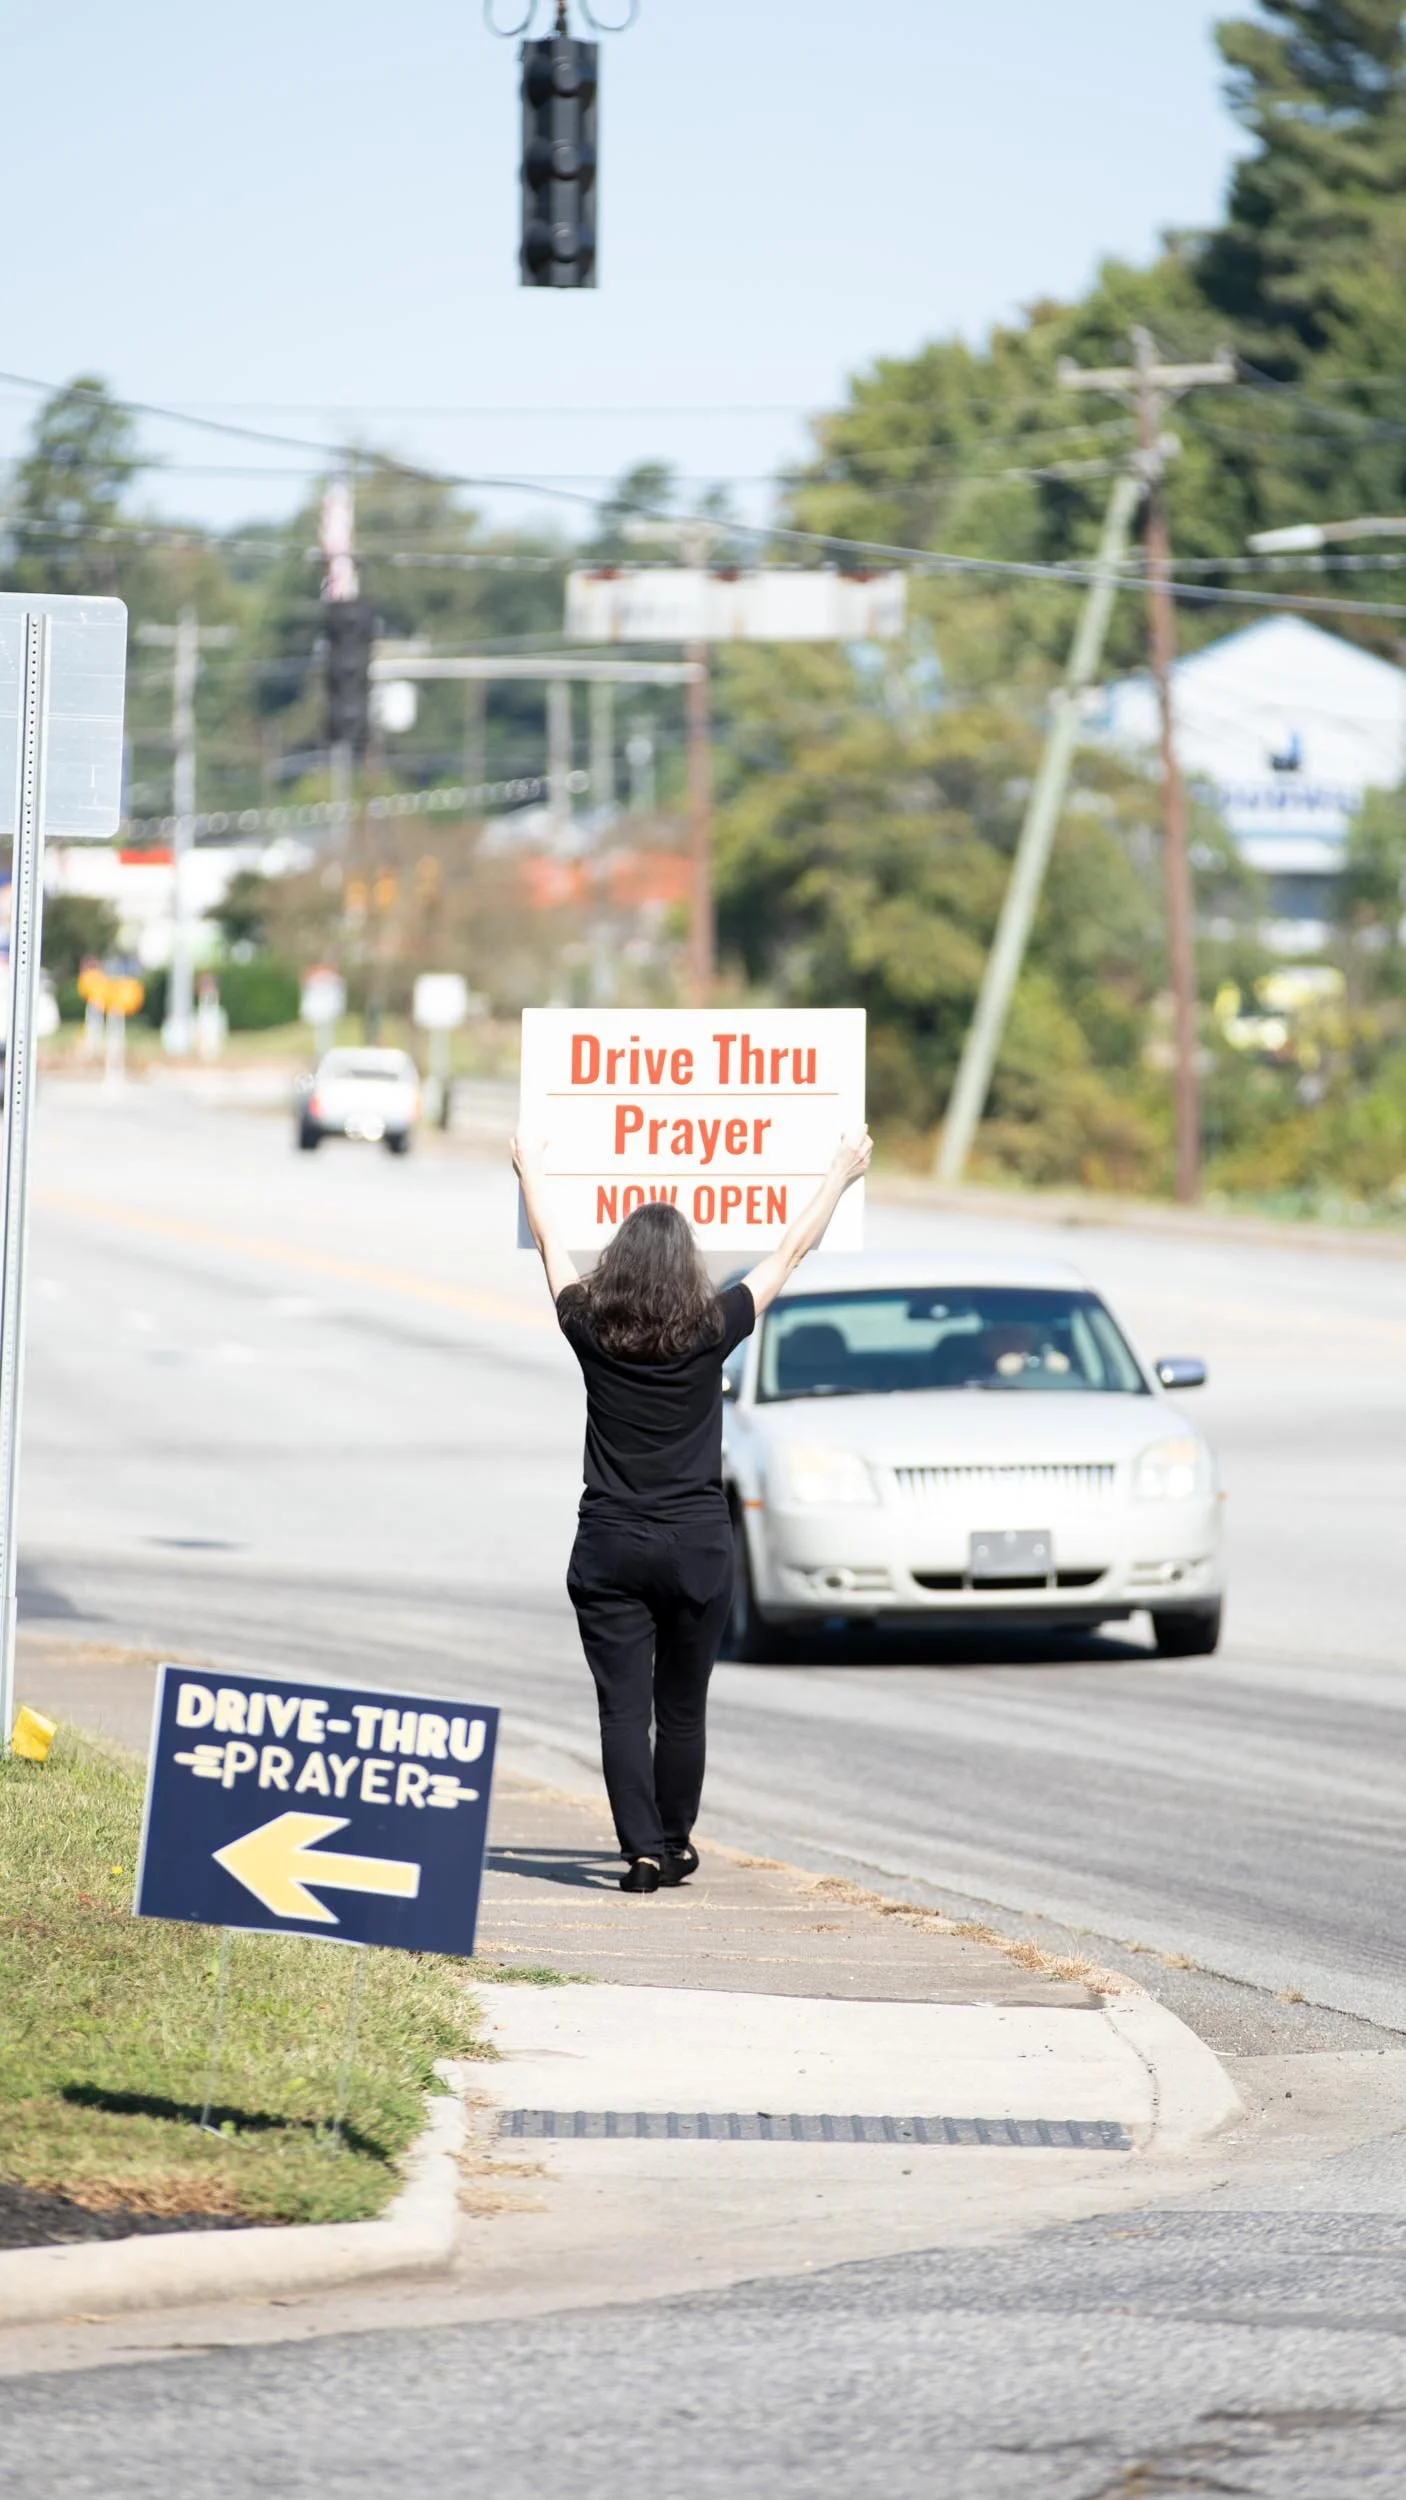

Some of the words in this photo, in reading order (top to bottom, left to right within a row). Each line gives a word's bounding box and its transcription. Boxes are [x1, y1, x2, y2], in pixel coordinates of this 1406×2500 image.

[571, 1034, 693, 1085] Drive
[713, 1034, 817, 1085] Thru
[614, 1105, 772, 1165] Prayer
[693, 1185, 787, 1225] OPEN
[176, 1683, 487, 1763] DRIVE-THRU
[222, 1741, 430, 1808] PRAYER
